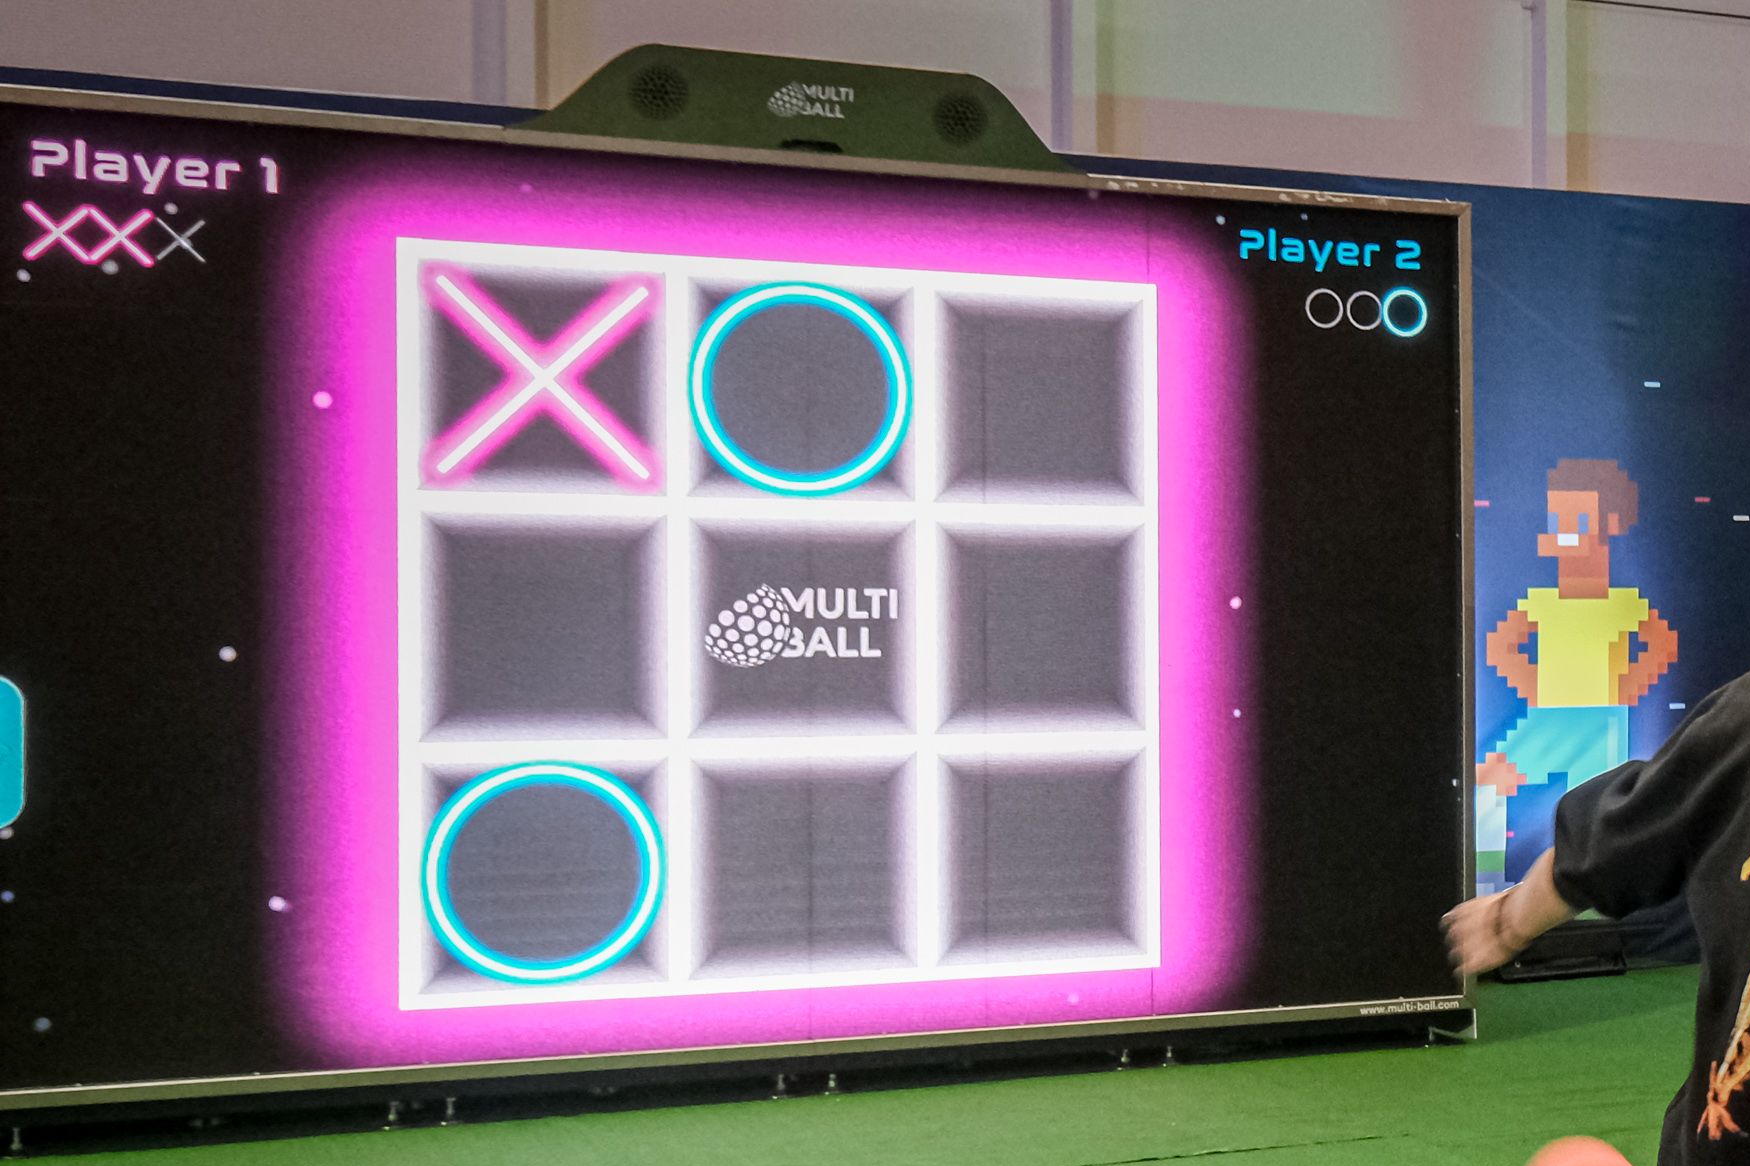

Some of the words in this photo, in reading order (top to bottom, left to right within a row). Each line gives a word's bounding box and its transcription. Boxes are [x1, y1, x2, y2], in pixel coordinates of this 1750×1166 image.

[801, 84, 854, 102] MULTI
[31, 139, 242, 194] Player
[259, 157, 280, 194] 1
[1240, 228, 1381, 272] Player
[1395, 239, 1421, 270] 2
[780, 587, 898, 619] MULTI
[780, 626, 882, 658] BALL
